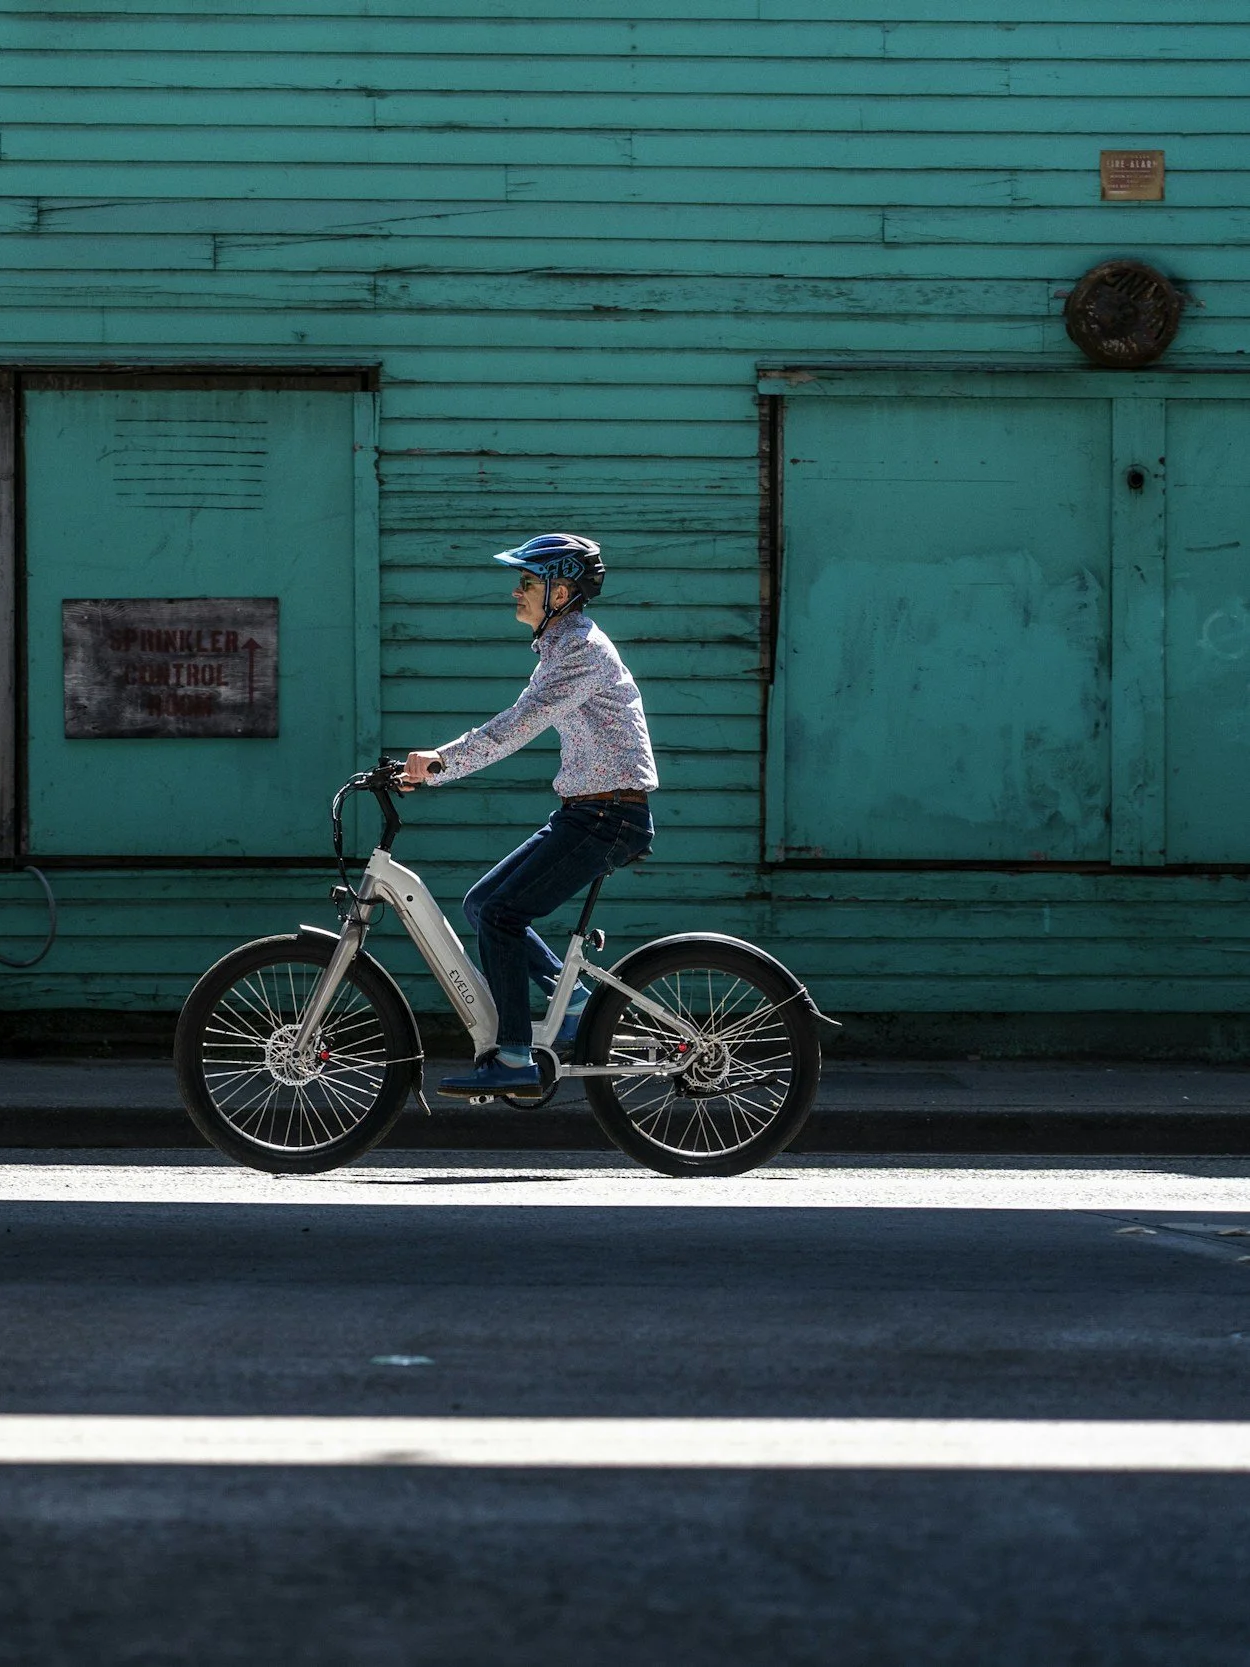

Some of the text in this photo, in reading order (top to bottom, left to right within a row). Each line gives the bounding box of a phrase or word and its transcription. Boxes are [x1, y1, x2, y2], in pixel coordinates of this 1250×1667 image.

[109, 628, 239, 653] SPRINKLER
[124, 662, 229, 687] CONTROL
[448, 969, 475, 1004] EVELO
